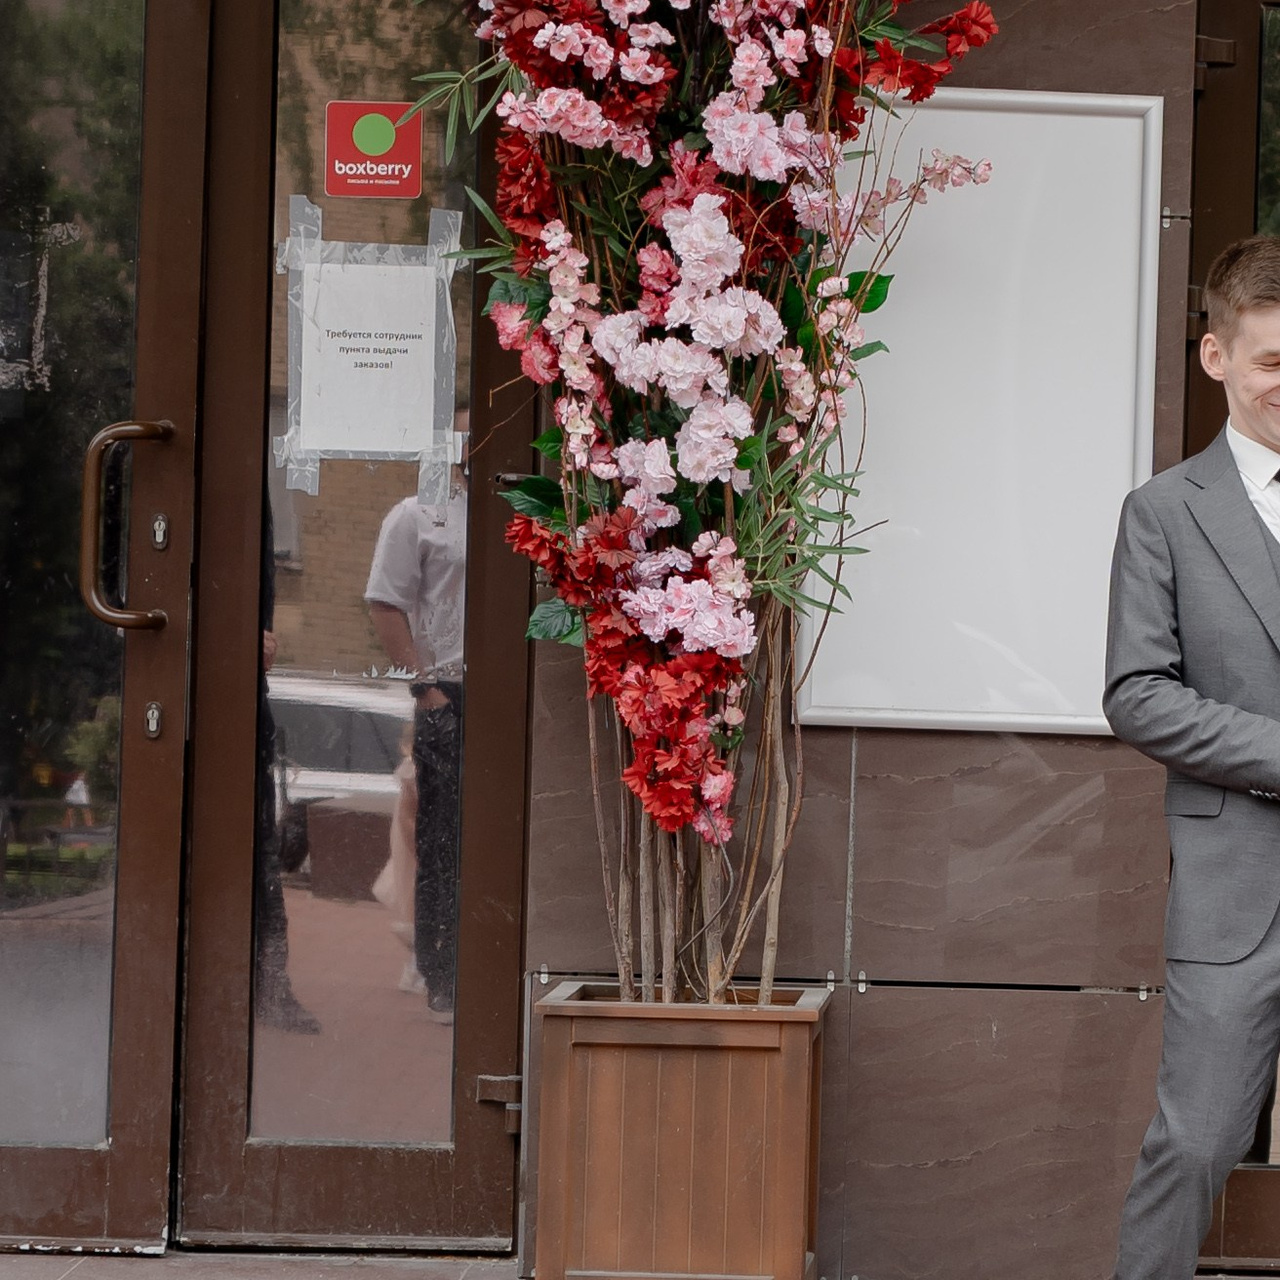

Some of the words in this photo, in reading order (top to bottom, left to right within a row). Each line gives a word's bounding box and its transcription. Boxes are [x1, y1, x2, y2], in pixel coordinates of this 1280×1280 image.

[334, 160, 412, 179] boxberry
[325, 329, 371, 339] Требуется
[374, 331, 422, 340] сотрудник
[339, 346, 370, 354] пункта
[372, 347, 408, 355] выдачи
[353, 361, 393, 369] заказов!
